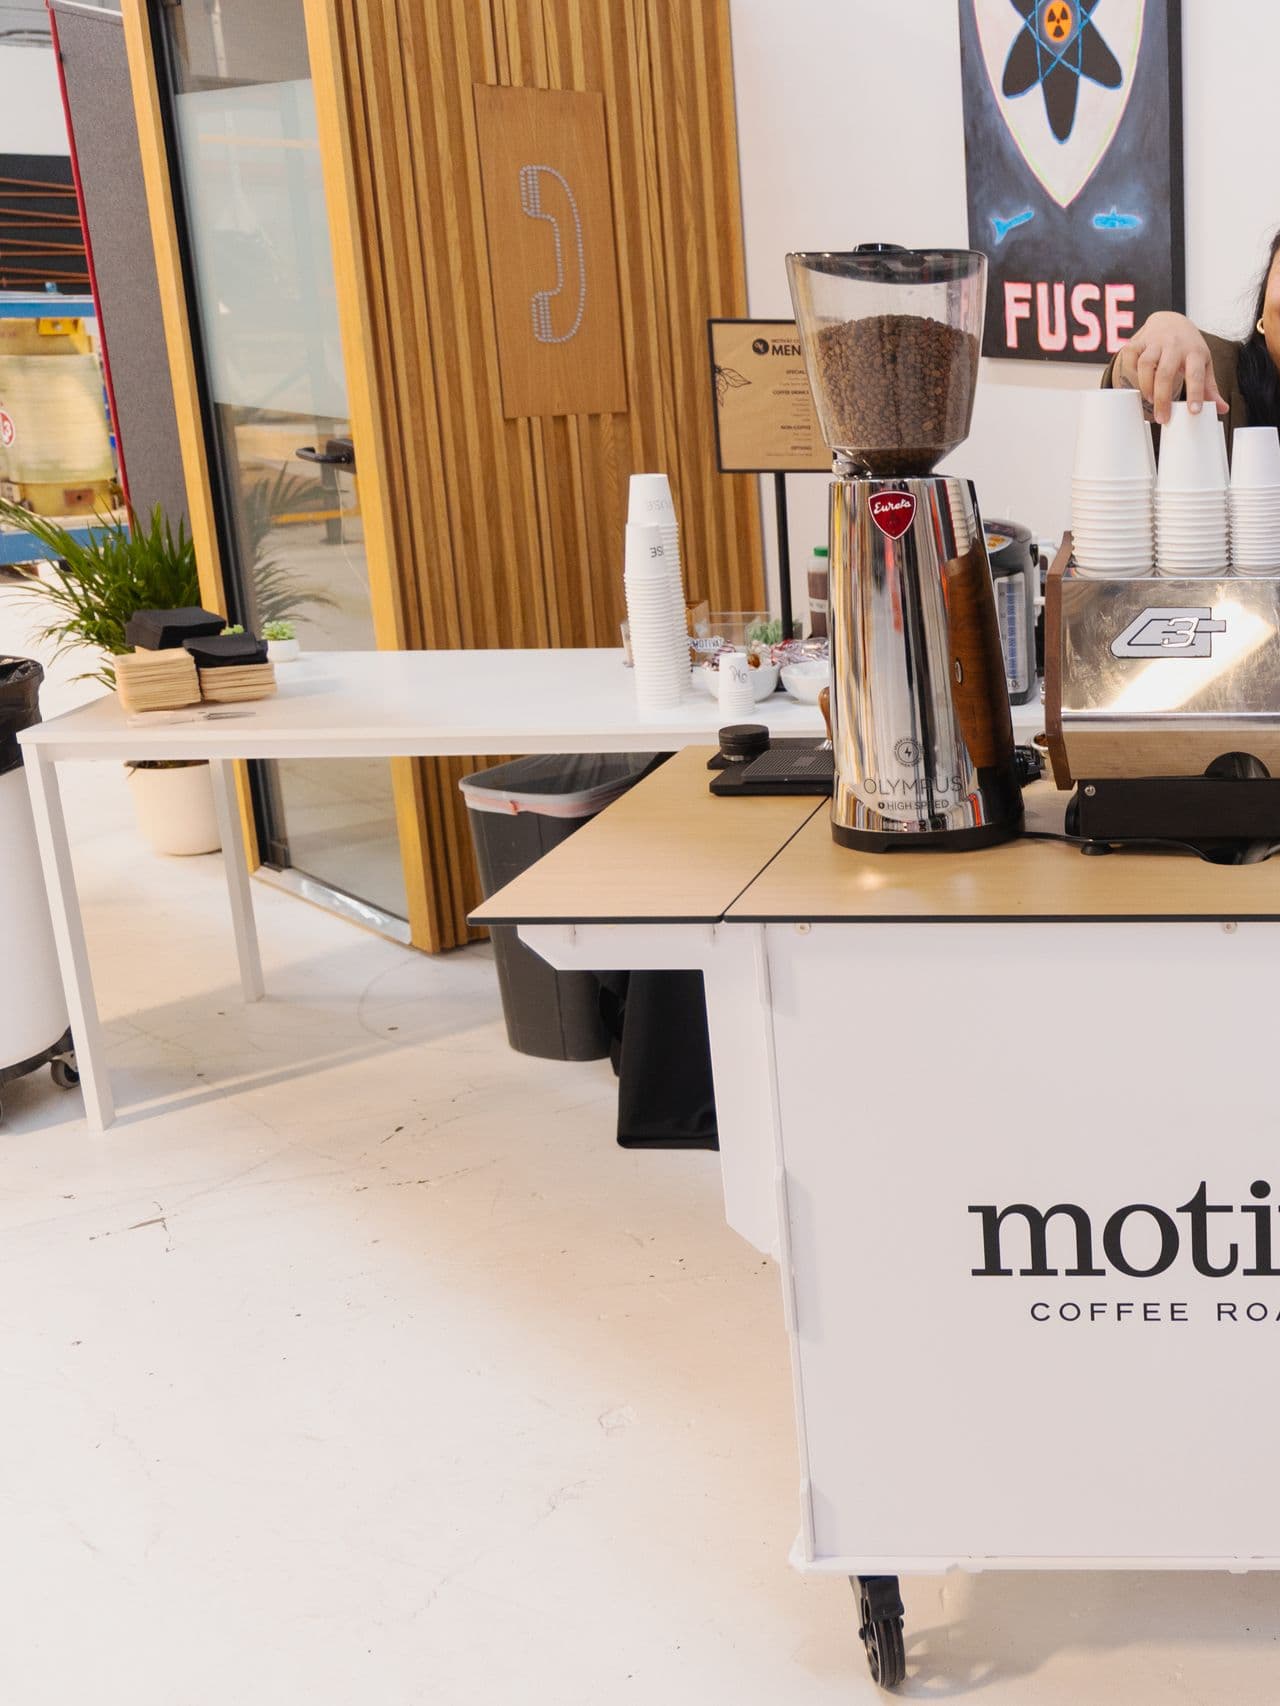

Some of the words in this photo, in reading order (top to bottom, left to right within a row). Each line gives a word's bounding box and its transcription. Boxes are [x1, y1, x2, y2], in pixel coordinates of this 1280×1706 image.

[1003, 281, 1136, 354] FUSE
[771, 344, 802, 356] MEN
[863, 776, 962, 796] OLYMPUS
[887, 801, 912, 811] HIGH
[914, 799, 950, 811] SPED
[1030, 1302, 1190, 1322] COFFEE
